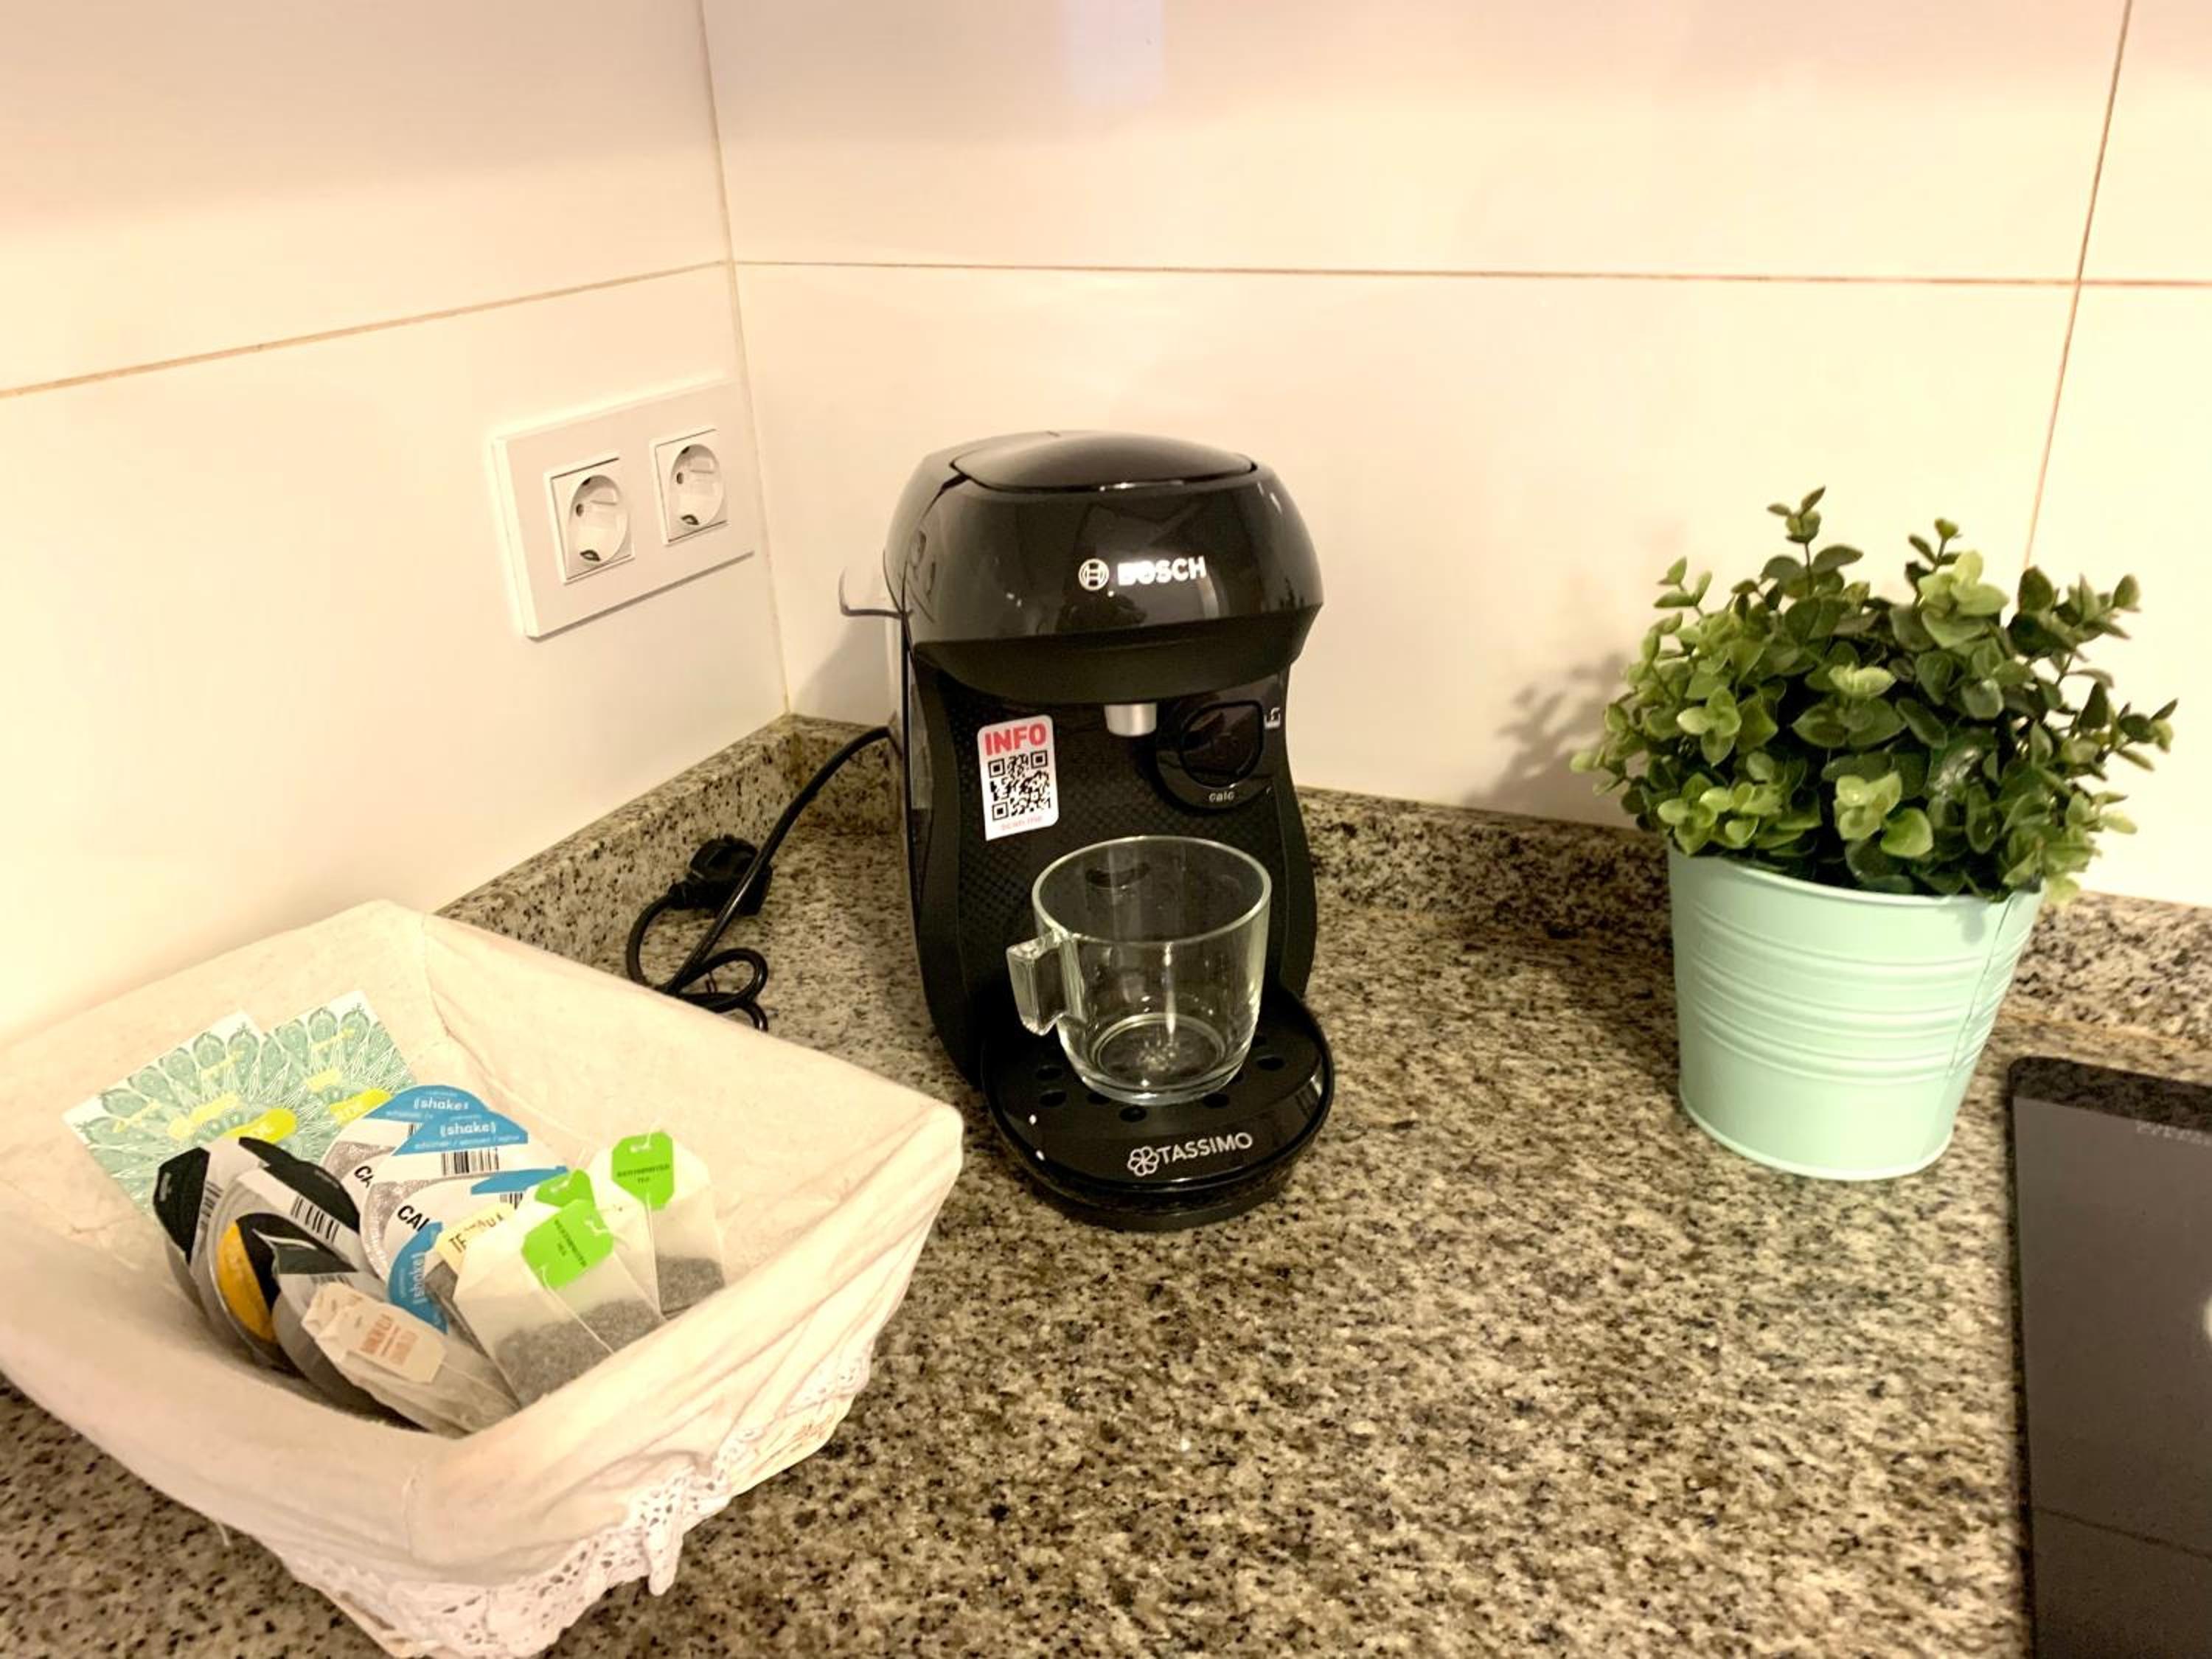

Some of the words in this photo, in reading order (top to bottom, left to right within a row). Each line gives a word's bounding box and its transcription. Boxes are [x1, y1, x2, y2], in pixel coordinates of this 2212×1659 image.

[1118, 555, 1207, 585] BOSCH
[984, 722, 1047, 755] INFO
[1155, 1132, 1253, 1164] TASSIMO
